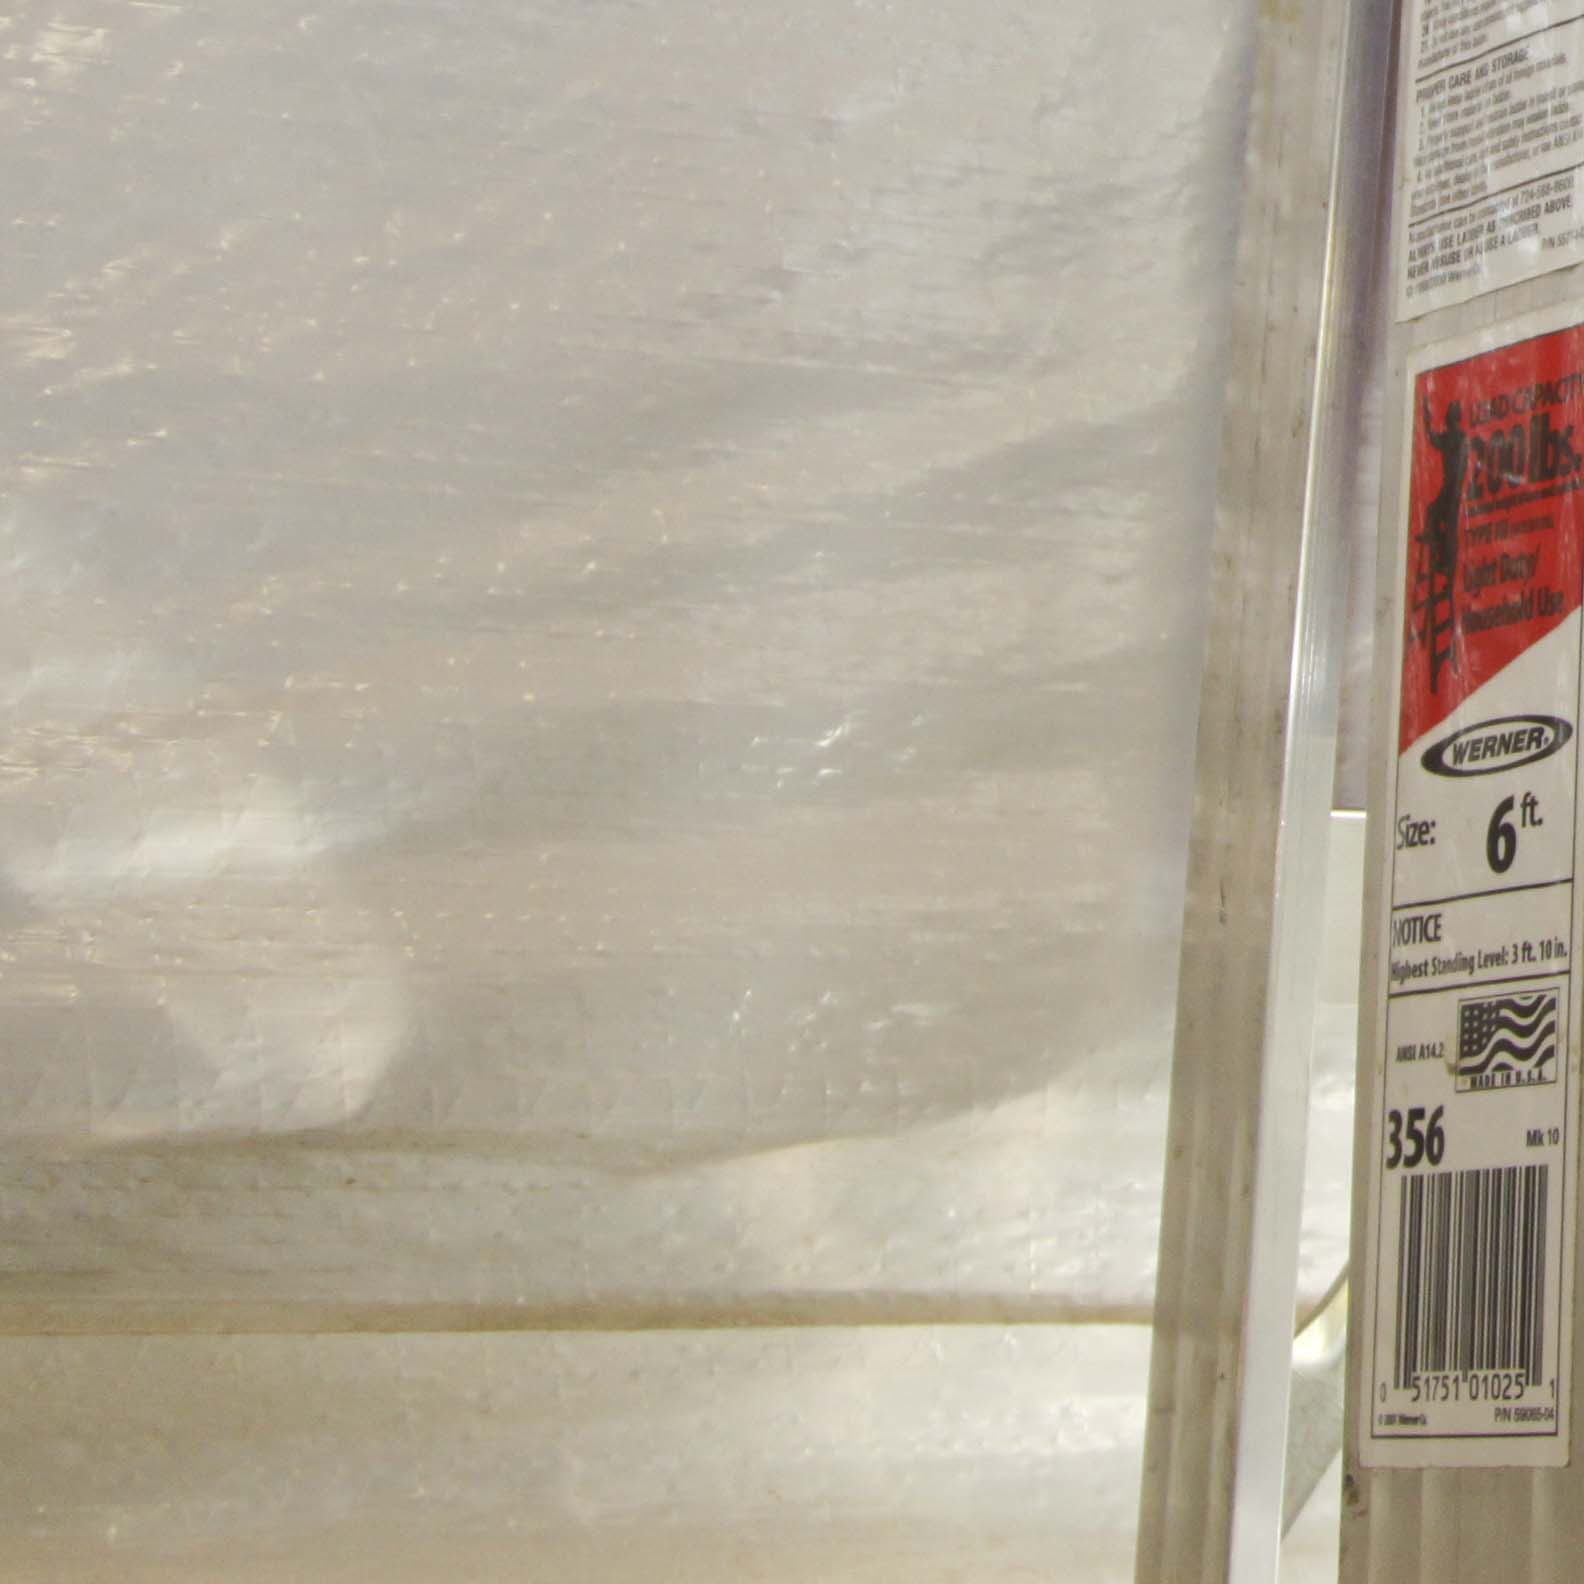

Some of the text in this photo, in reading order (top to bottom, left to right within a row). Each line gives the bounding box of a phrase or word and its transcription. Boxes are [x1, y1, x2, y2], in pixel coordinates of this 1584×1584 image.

[1512, 372, 1584, 414] CAPACITY
[1469, 412, 1582, 500] 200 lbs.
[1463, 561, 1496, 594] Light
[1462, 585, 1564, 634] Household Use
[1452, 726, 1545, 767] WERNER
[1396, 792, 1543, 874] Size: 6 ft.
[1393, 914, 1442, 948] NOTICE
[1391, 936, 1568, 985] Highest Standing Level: 3 ft. 10 in.
[1418, 1041, 1445, 1060] A14.2
[1470, 1074, 1497, 1089] MADE
[1500, 1072, 1511, 1086] IN
[1385, 1105, 1445, 1170] 356
[1379, 1382, 1387, 1402] 0
[1411, 1374, 1460, 1401] 51751
[1469, 1372, 1525, 1400] 01025
